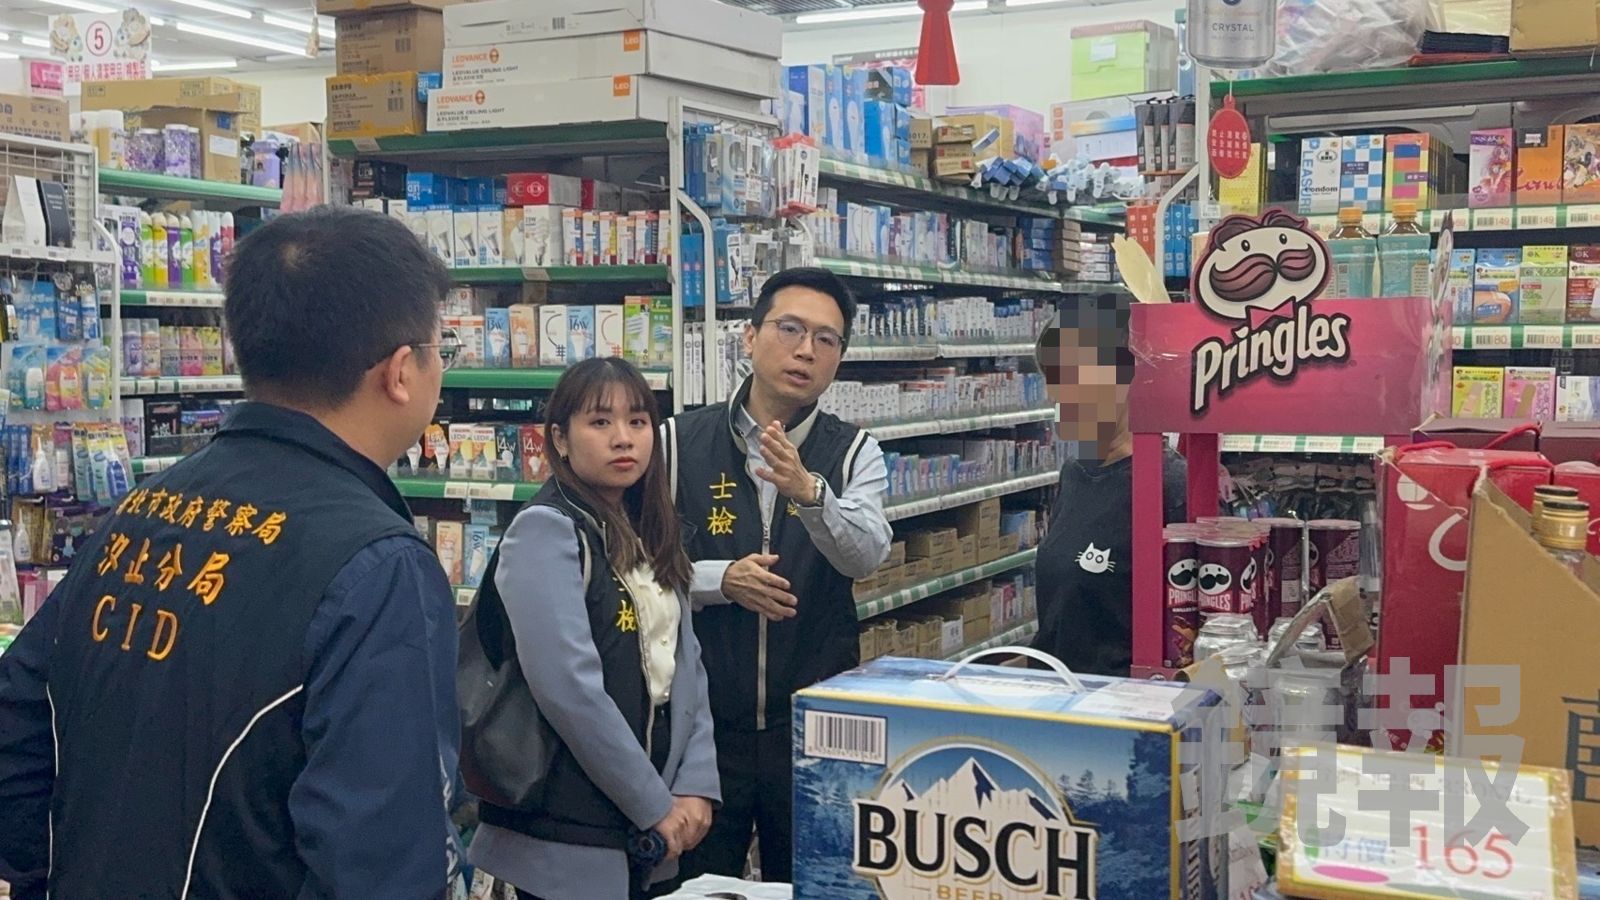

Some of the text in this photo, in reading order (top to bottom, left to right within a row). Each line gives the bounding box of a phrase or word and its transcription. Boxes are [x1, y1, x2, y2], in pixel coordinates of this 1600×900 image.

[94, 28, 104, 50] 5
[625, 36, 639, 45] LED
[1211, 22, 1254, 32] CRYSTAL
[452, 53, 488, 63] LEDVANCE
[436, 94, 473, 105] LEDVANCE
[1193, 304, 1349, 412] Pringles
[707, 471, 738, 536] 士檢
[98, 533, 231, 605] 汐止分局
[92, 594, 179, 661] CID
[856, 801, 1093, 900] BUSCH
[1412, 824, 1514, 879] 165
[937, 884, 1003, 900] BEER
